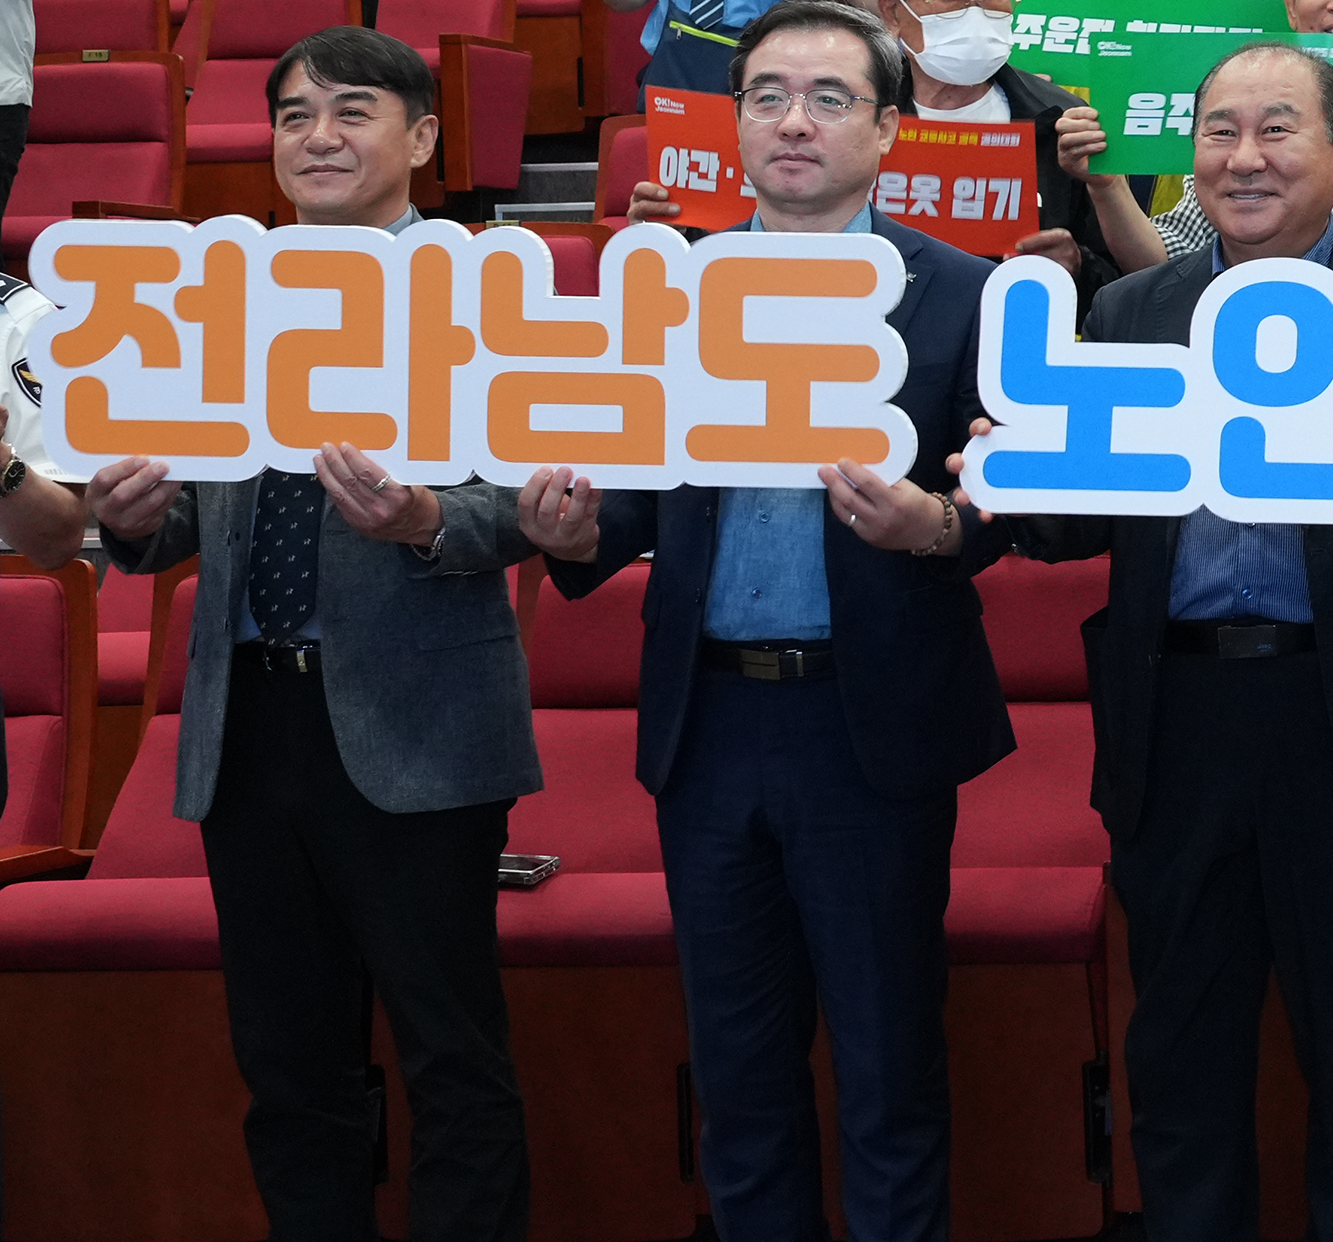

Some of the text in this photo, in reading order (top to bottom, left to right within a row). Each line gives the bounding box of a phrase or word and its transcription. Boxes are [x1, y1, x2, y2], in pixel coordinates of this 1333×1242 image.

[660, 146, 720, 192] 야간
[952, 176, 1022, 220] 입기
[51, 239, 890, 465] 전라남도
